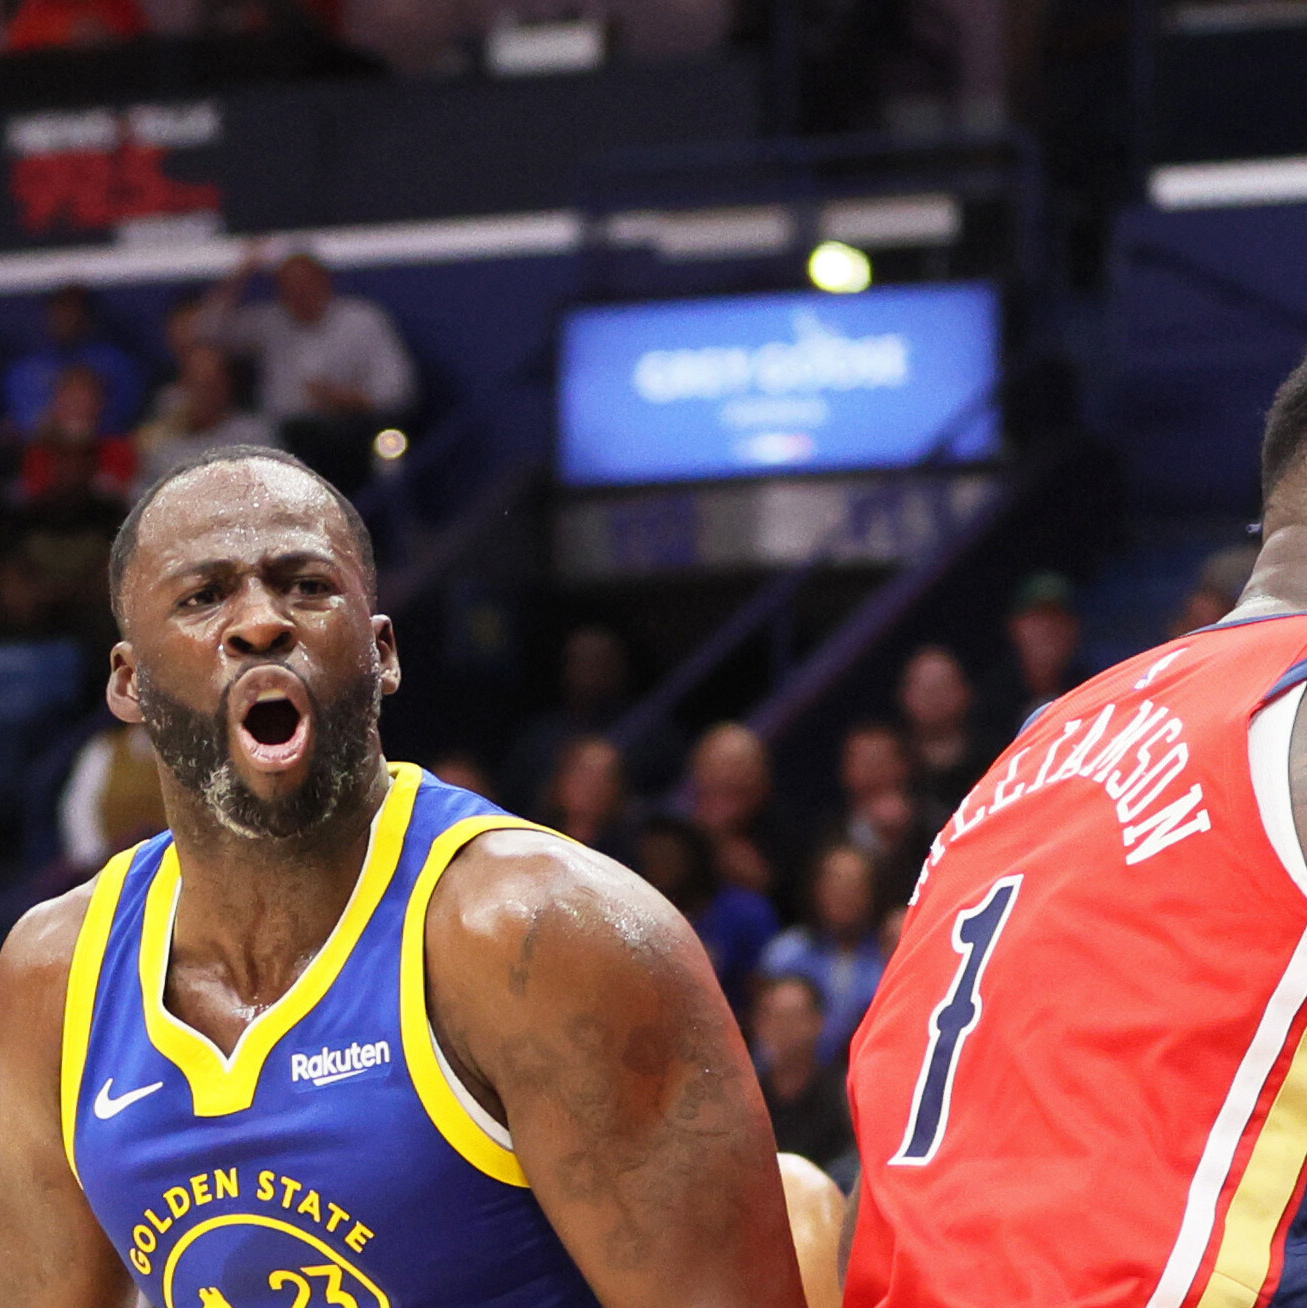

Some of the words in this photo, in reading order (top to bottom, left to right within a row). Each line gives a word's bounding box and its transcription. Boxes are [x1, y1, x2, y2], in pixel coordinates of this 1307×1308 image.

[291, 1040, 391, 1082] Rakuten
[887, 873, 1024, 1166] 1
[128, 1167, 240, 1276] GOLDEN
[256, 1169, 378, 1254] STATE
